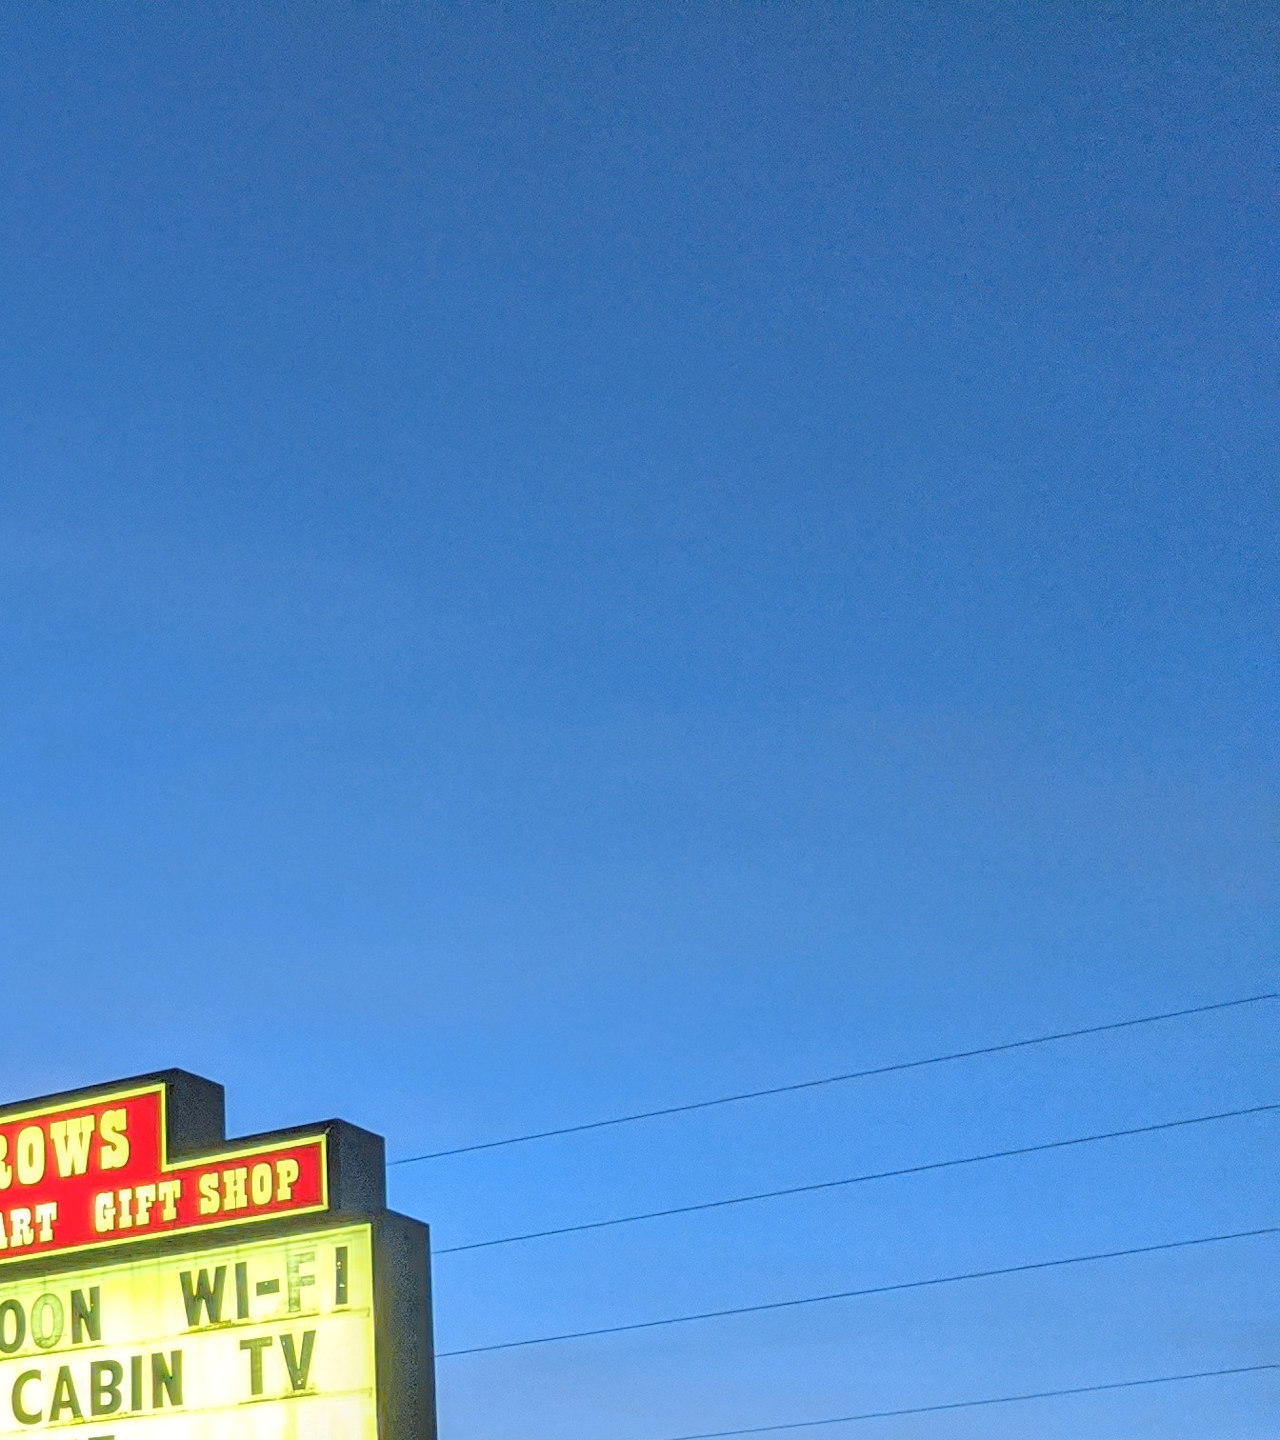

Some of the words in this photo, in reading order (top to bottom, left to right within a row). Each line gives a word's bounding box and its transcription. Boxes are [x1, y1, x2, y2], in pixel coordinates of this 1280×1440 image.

[94, 1180, 181, 1233] GIFT
[198, 1159, 300, 1214] SHOP
[179, 1246, 349, 1327] WI-FI
[11, 1349, 183, 1425] CABIN
[239, 1330, 317, 1396] TV
